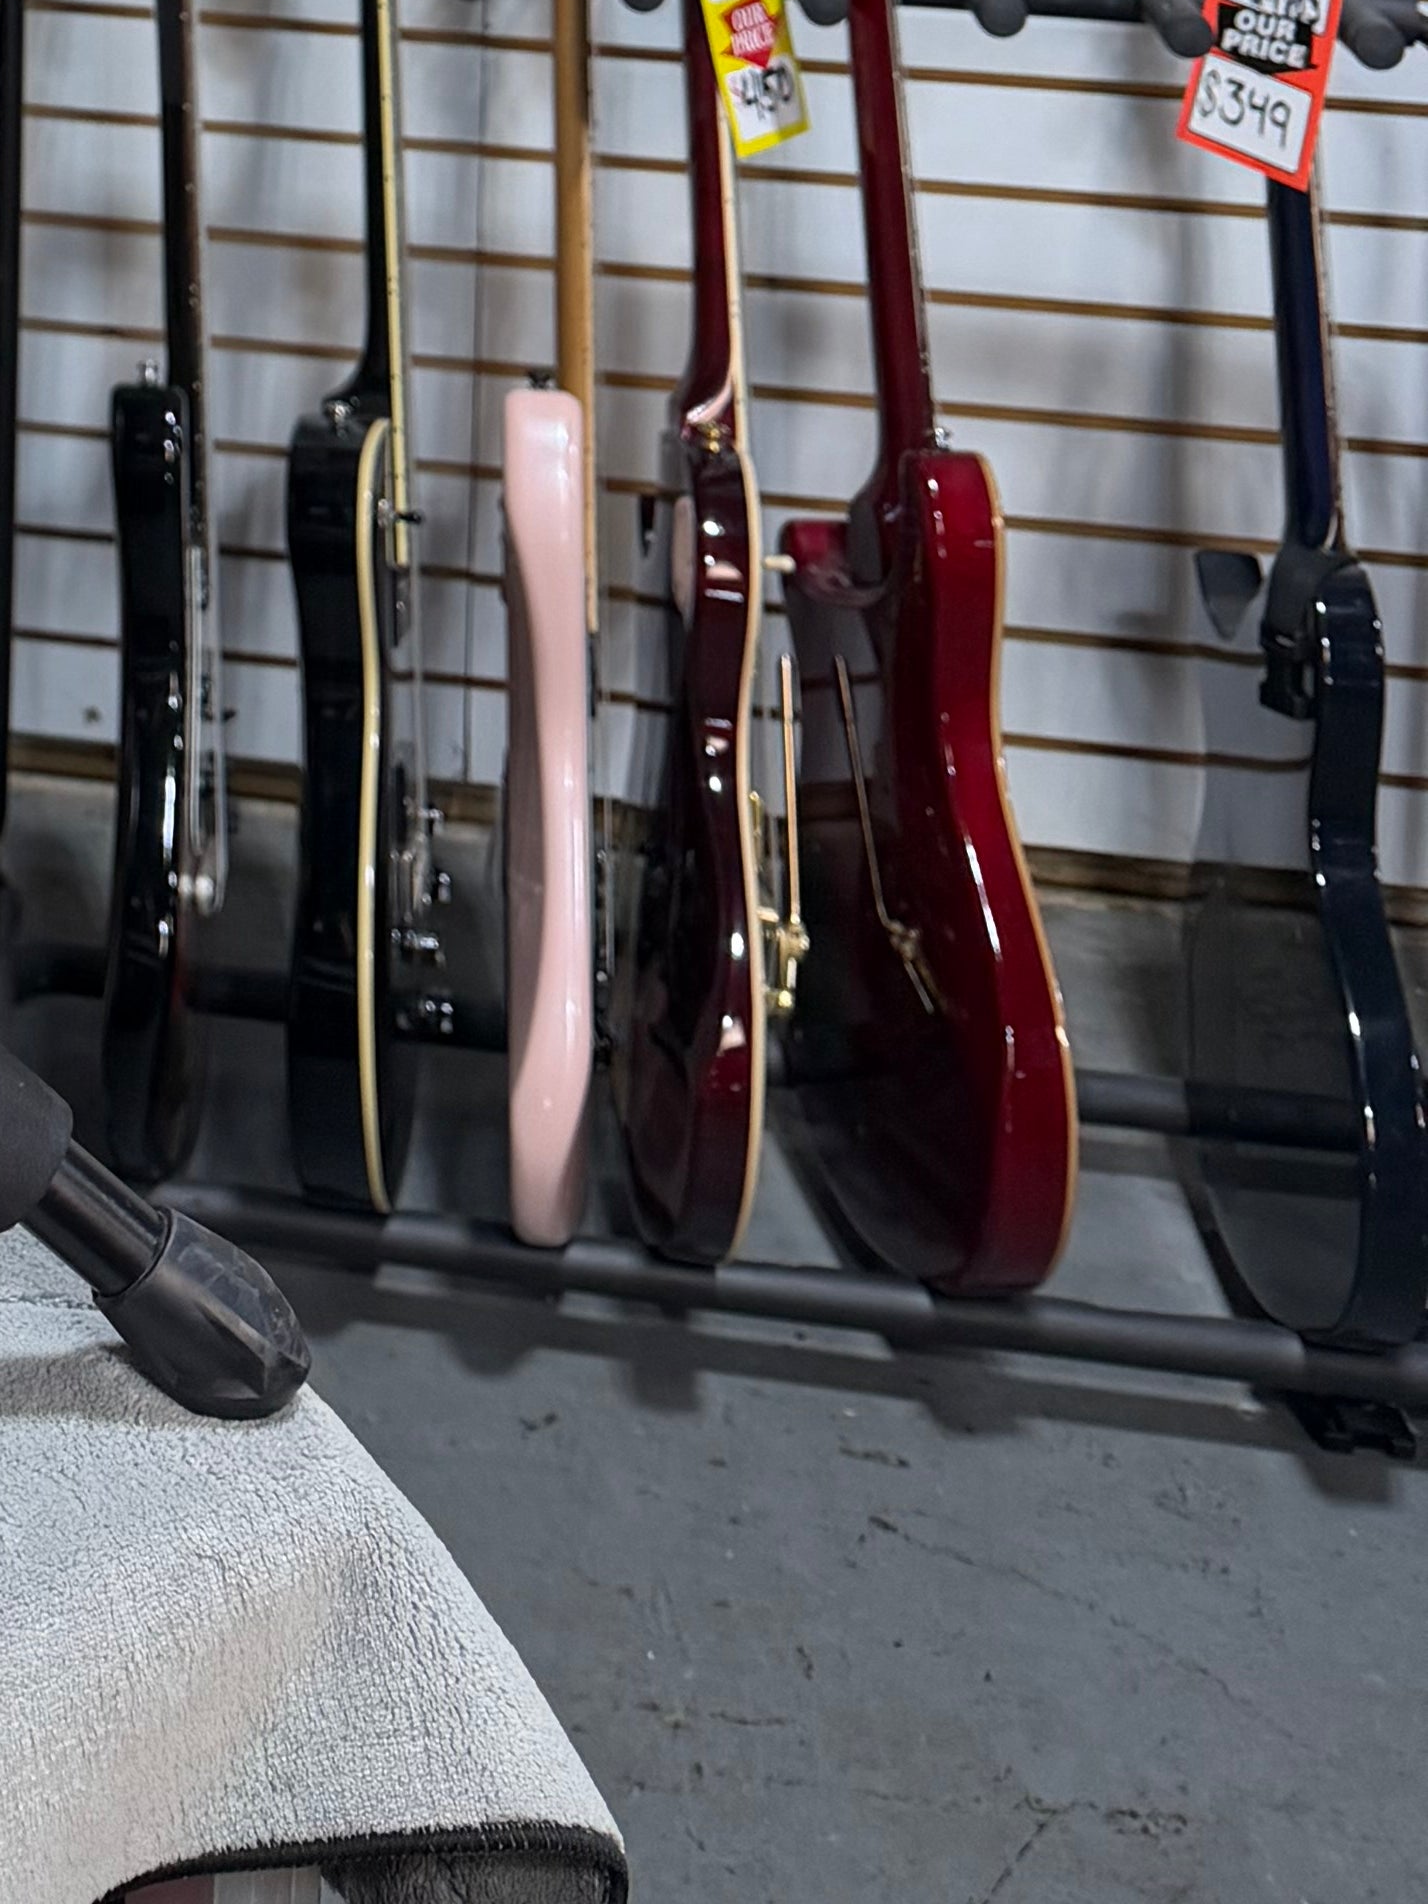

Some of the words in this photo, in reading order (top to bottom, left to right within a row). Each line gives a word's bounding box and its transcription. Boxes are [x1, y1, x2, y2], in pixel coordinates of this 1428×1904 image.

[1234, 8, 1296, 41] OUR
[1220, 28, 1310, 70] PRICE
[1197, 69, 1292, 150] $349
